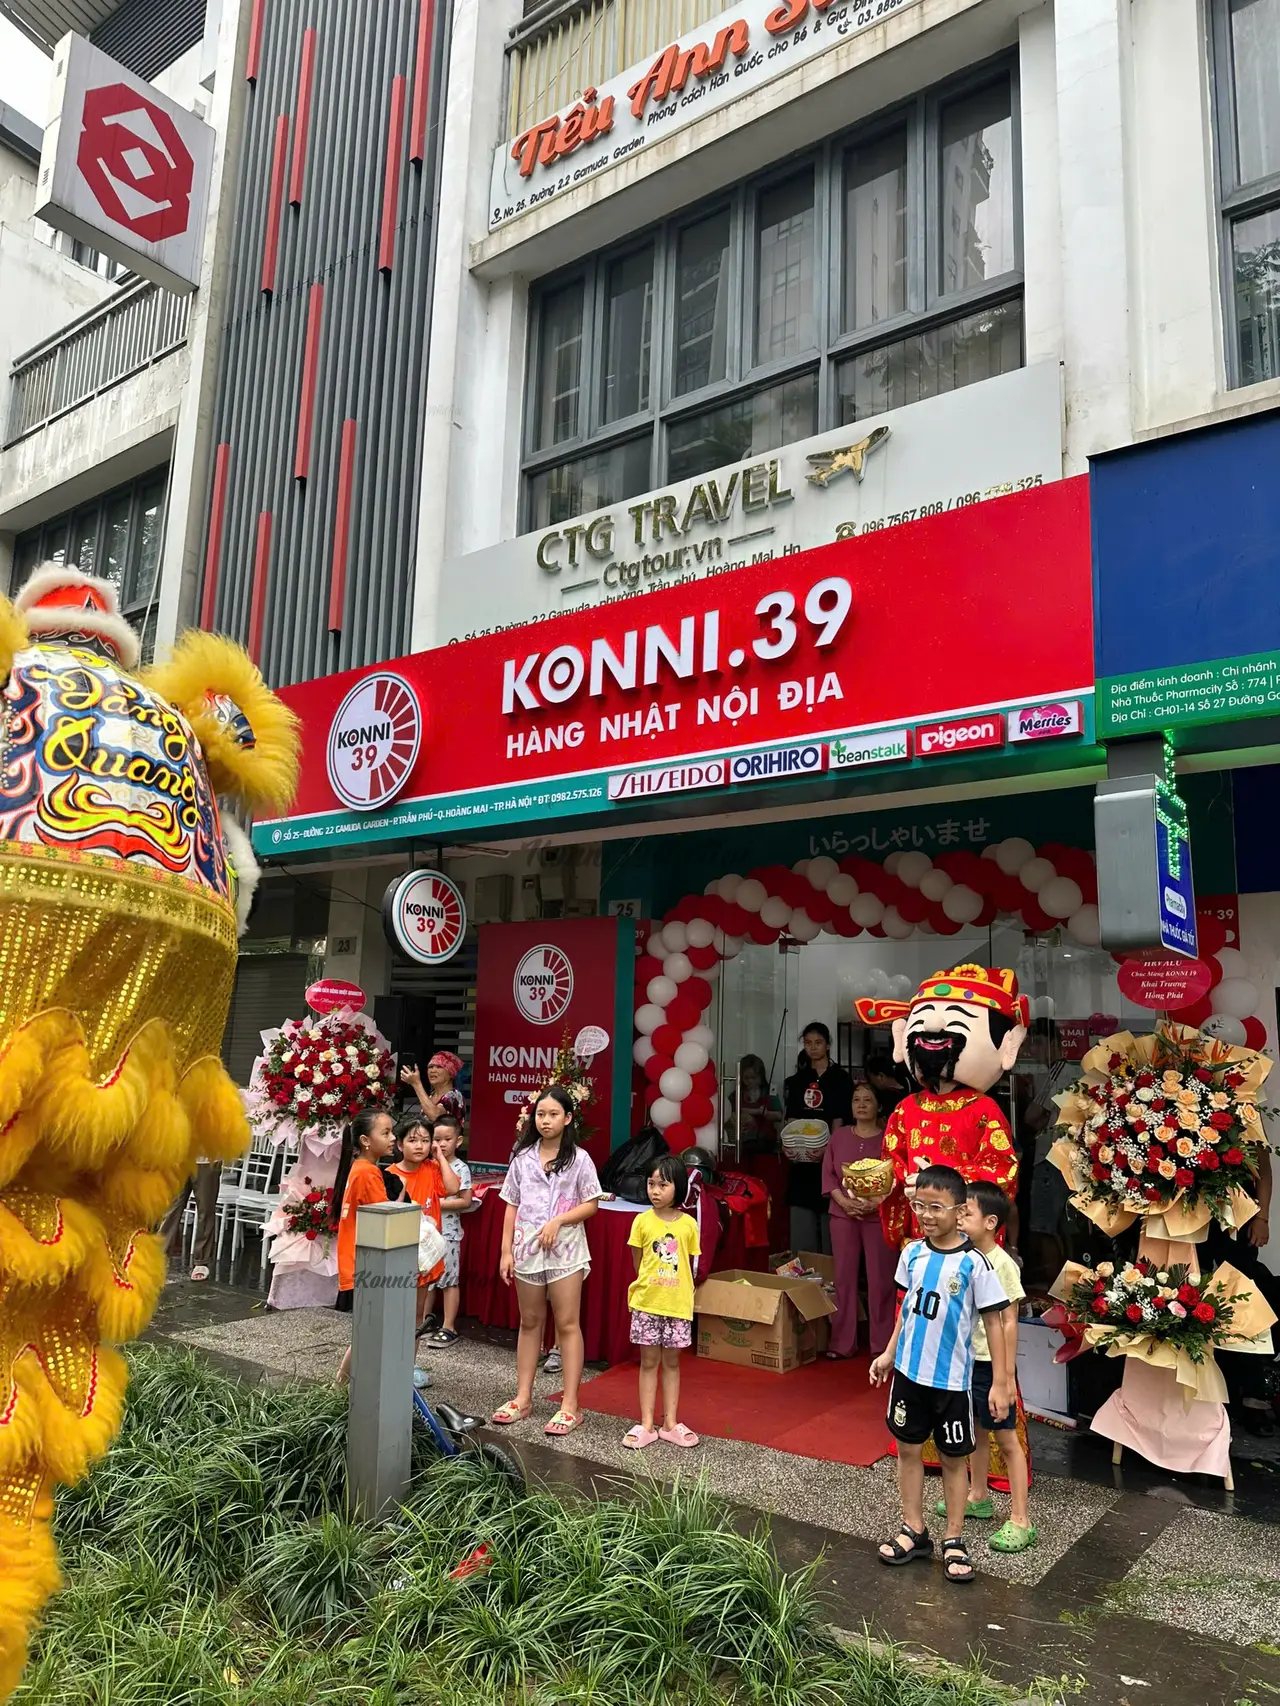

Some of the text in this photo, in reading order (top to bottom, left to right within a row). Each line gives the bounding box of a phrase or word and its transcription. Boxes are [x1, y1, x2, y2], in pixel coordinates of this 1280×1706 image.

[627, 18, 750, 120] Ann
[647, 102, 677, 126] Phong
[681, 84, 706, 105] cách
[709, 72, 729, 93] Hàn
[734, 51, 764, 77] Quốc
[768, 41, 789, 60] cho
[813, 19, 823, 32] &
[826, 8, 847, 26] Gia
[503, 206, 514, 219] No
[529, 184, 555, 205] Đường
[557, 175, 571, 191] 2.2
[573, 155, 609, 181] Gamuda
[613, 135, 645, 160] Garden
[536, 458, 795, 573] CTG TRAVEL
[887, 508, 917, 528] 7567
[919, 501, 943, 518] 808
[603, 536, 723, 589] Ctgtour.vn
[502, 576, 853, 715] KONNI.39
[1110, 684, 1127, 695] Địa
[1129, 678, 1155, 692] điểm
[1156, 675, 1178, 688] kinh
[1180, 670, 1214, 684] doanh
[1222, 665, 1240, 677] Chi
[1241, 660, 1277, 675] nhánh
[1111, 696, 1132, 709] Nhà
[1134, 690, 1164, 705] Thuốc
[1165, 683, 1223, 701] Pharmacity
[1247, 678, 1267, 690] 774
[1111, 713, 1128, 723] Địa
[1130, 708, 1147, 720] Chỉ
[1154, 702, 1195, 716] CH01-14
[1197, 699, 1211, 711] Số
[1213, 698, 1226, 708] 27
[1228, 693, 1265, 708] Đường
[506, 671, 844, 758] HÀNG NHẬT NỘI ĐỊA
[1019, 714, 1072, 734] Merries
[338, 721, 390, 749] KONNI
[921, 722, 995, 752] pigeon
[351, 744, 377, 771] 39
[733, 747, 819, 779] ORIHIRO
[837, 742, 906, 764] beanstalk
[610, 764, 722, 798] SHISEIDO
[282, 828, 292, 841] SỐ
[335, 822, 362, 834] GAMUDA
[472, 805, 489, 815] MAI
[518, 796, 532, 809] NỘI
[551, 787, 602, 803] 0982.575.126
[809, 817, 991, 856] いらっしゃいませ
[406, 902, 444, 919] KONNI
[616, 902, 634, 917] 25
[1216, 908, 1234, 920] 39
[416, 917, 436, 933] 39
[520, 974, 554, 986] KONNI
[529, 986, 546, 1000] 39
[1141, 980, 1158, 988] Khai
[1166, 991, 1184, 999] Phát
[1061, 1038, 1077, 1048] GIÁ
[488, 1070, 517, 1083] HÀNG
[912, 1286, 941, 1321] 10
[942, 1420, 964, 1444] 10
